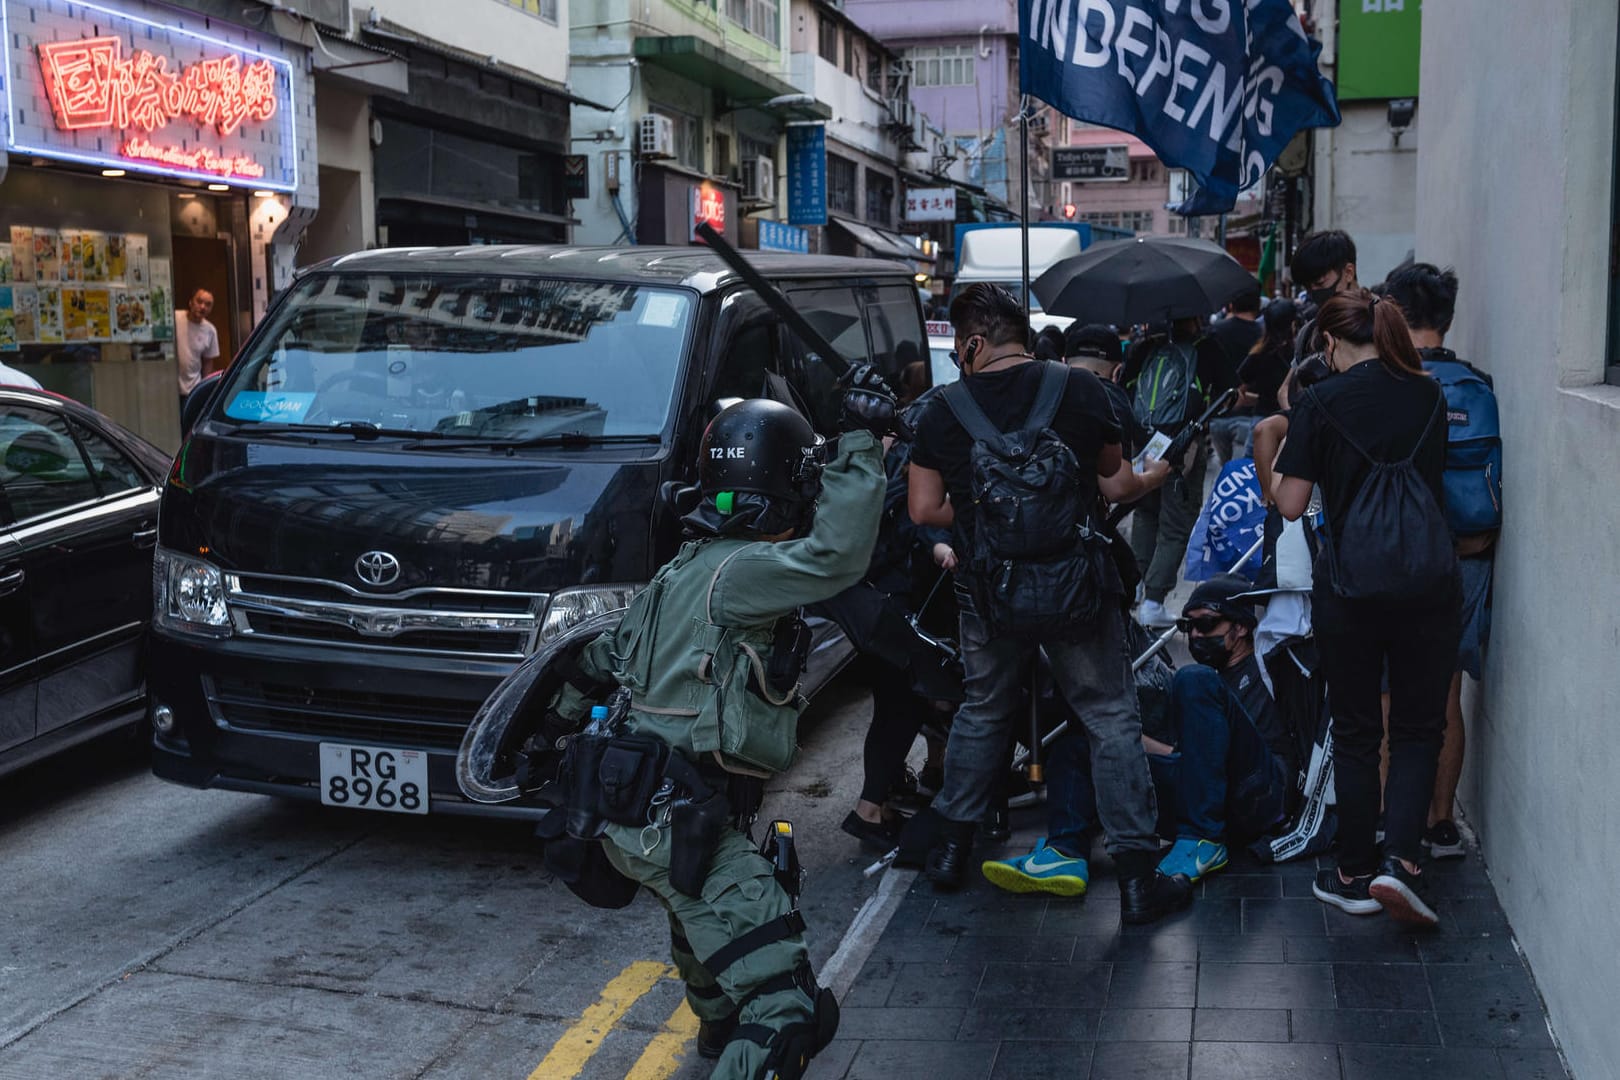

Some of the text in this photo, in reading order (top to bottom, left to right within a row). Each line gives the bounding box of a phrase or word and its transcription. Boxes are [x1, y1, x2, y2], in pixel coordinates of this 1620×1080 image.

[126, 137, 201, 169] International
[710, 447, 745, 459] T2 KE
[351, 748, 396, 780] RG
[329, 775, 420, 810] 8968
